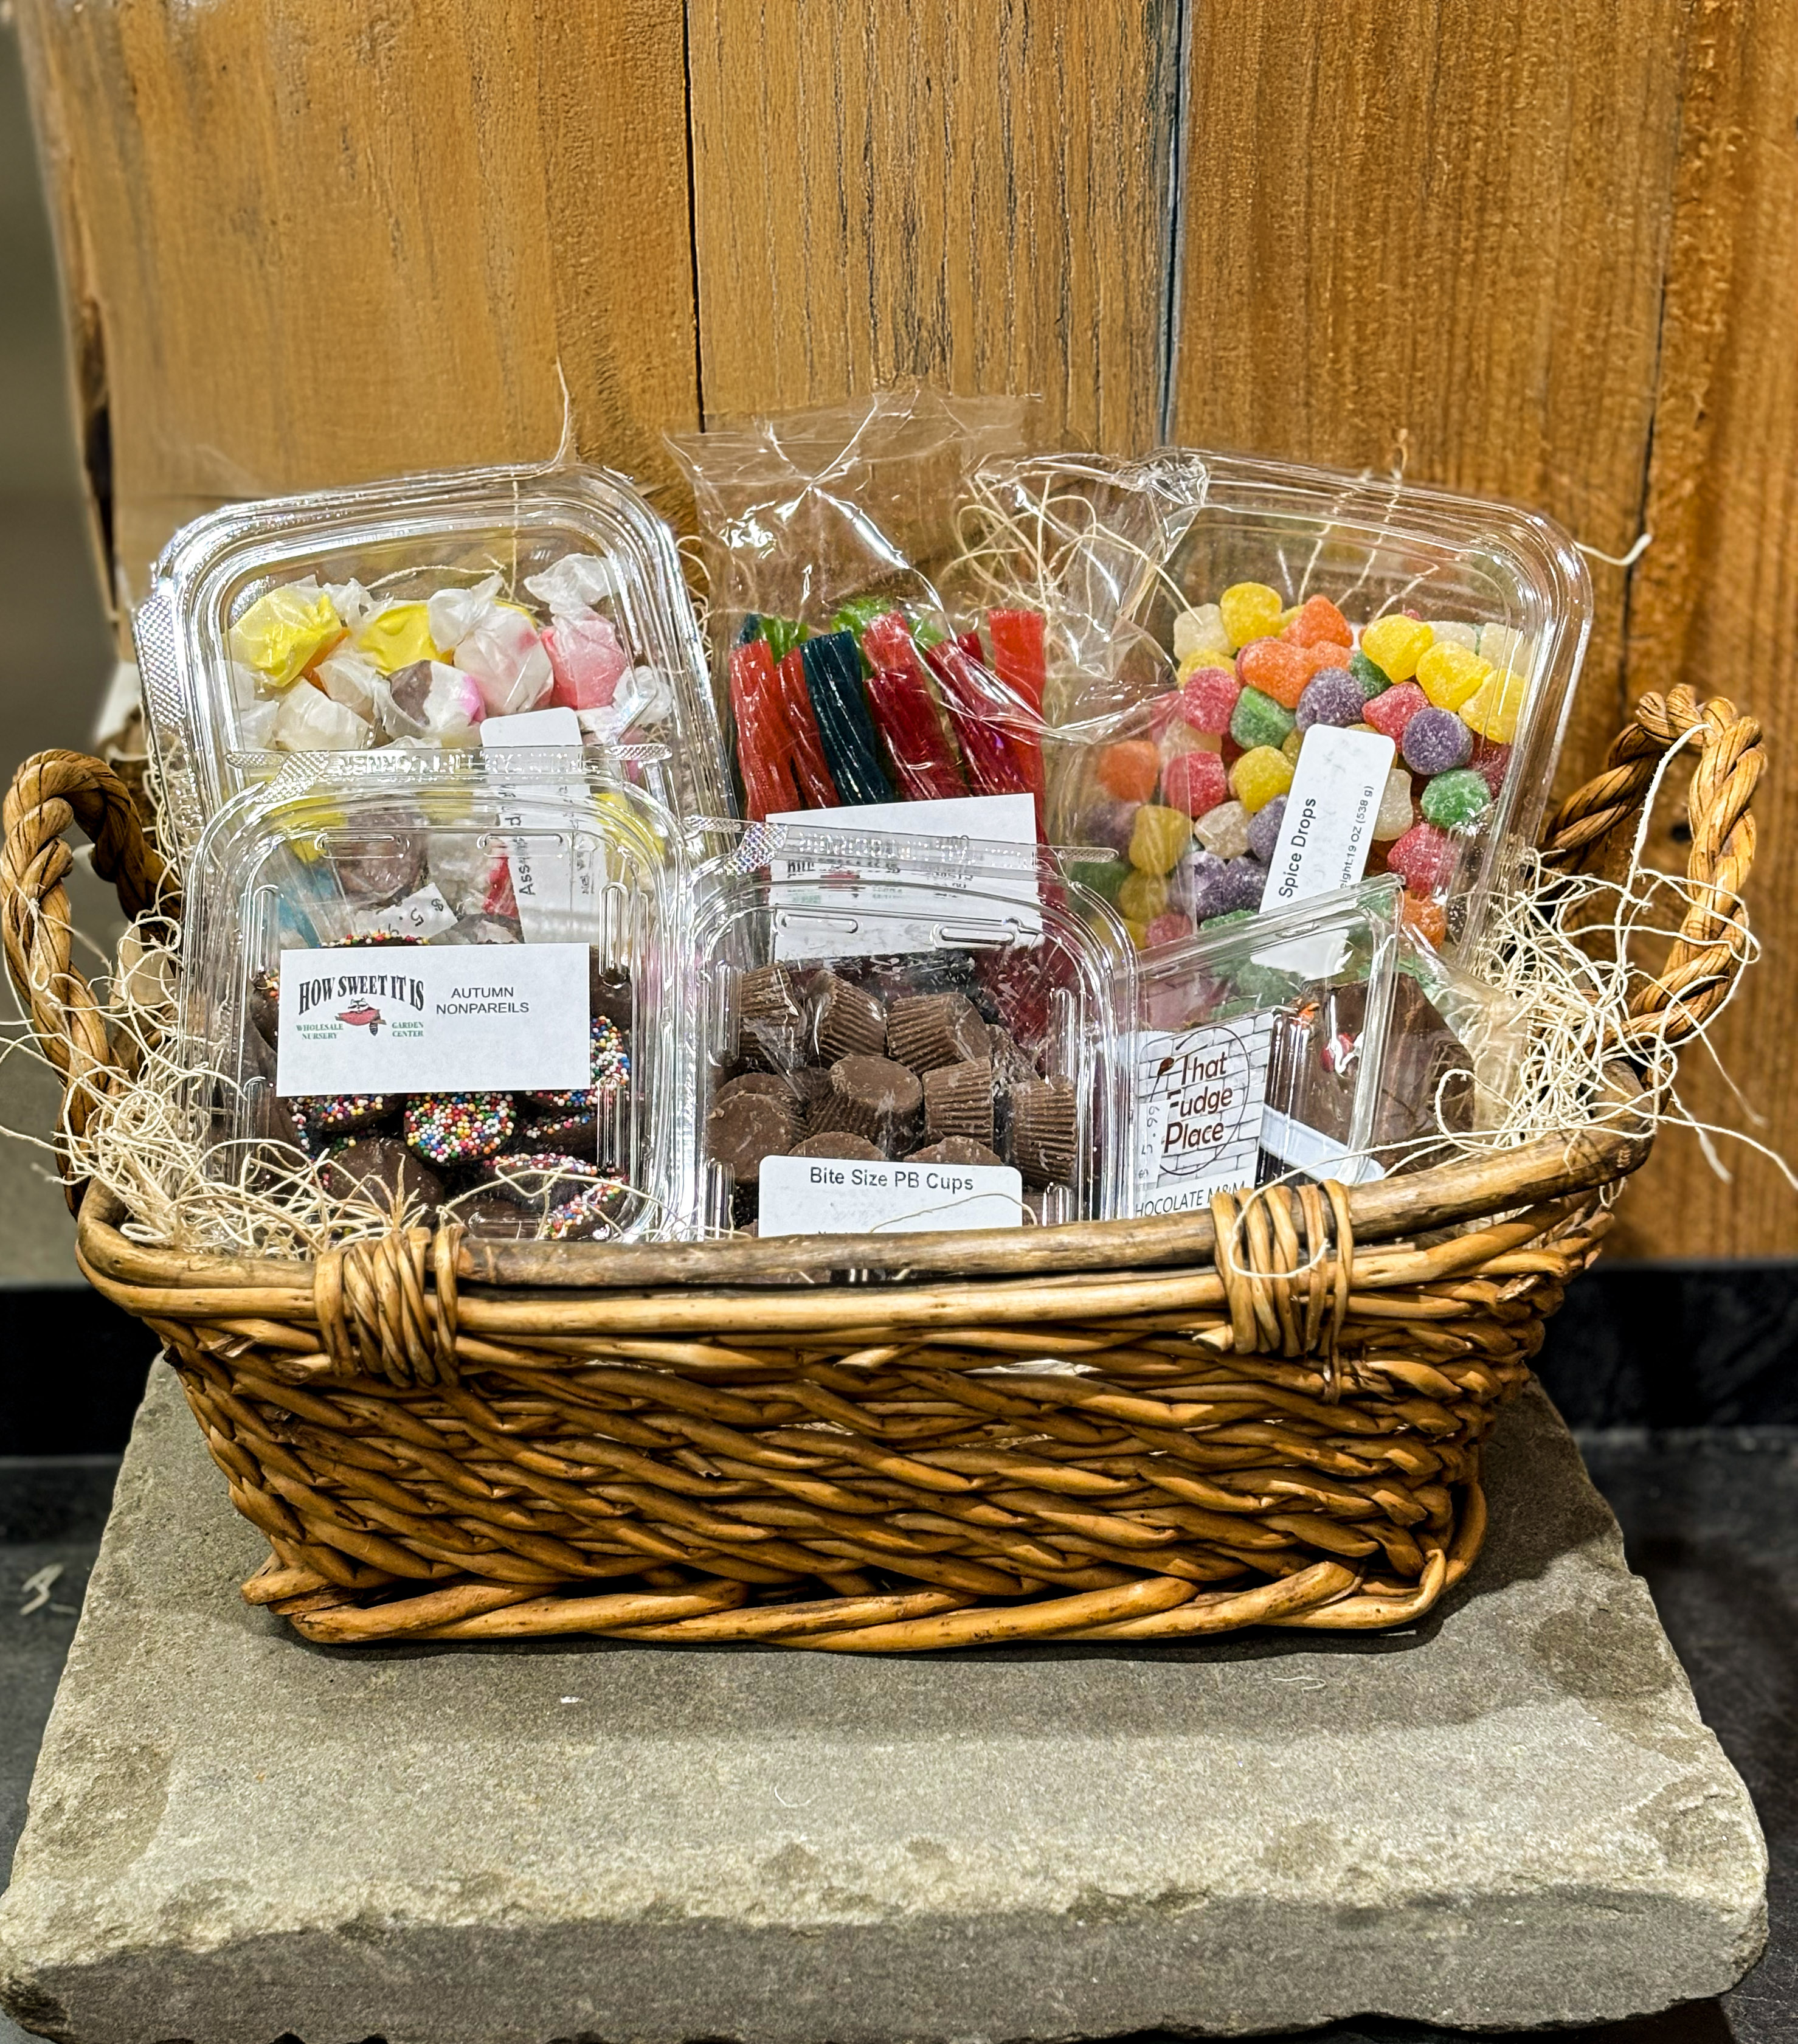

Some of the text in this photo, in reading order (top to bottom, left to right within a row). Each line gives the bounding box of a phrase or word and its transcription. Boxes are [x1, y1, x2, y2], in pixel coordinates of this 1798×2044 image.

[1278, 797, 1316, 898] Spice Drops
[1340, 845, 1357, 889] eight:19
[1351, 826, 1363, 843] OZ
[299, 974, 424, 1015] HOW SWEET IT IS
[436, 1002, 530, 1014] NONPAREILS
[451, 986, 514, 999] AUTUMN
[296, 1023, 344, 1031] WHOLESALE
[1178, 1047, 1228, 1085] That
[1167, 1086, 1233, 1117] Fudge
[1164, 1120, 1225, 1154] Place
[810, 1166, 974, 1194] Bite Size PB Cups
[1136, 1190, 1204, 1216] HOCOLATE
